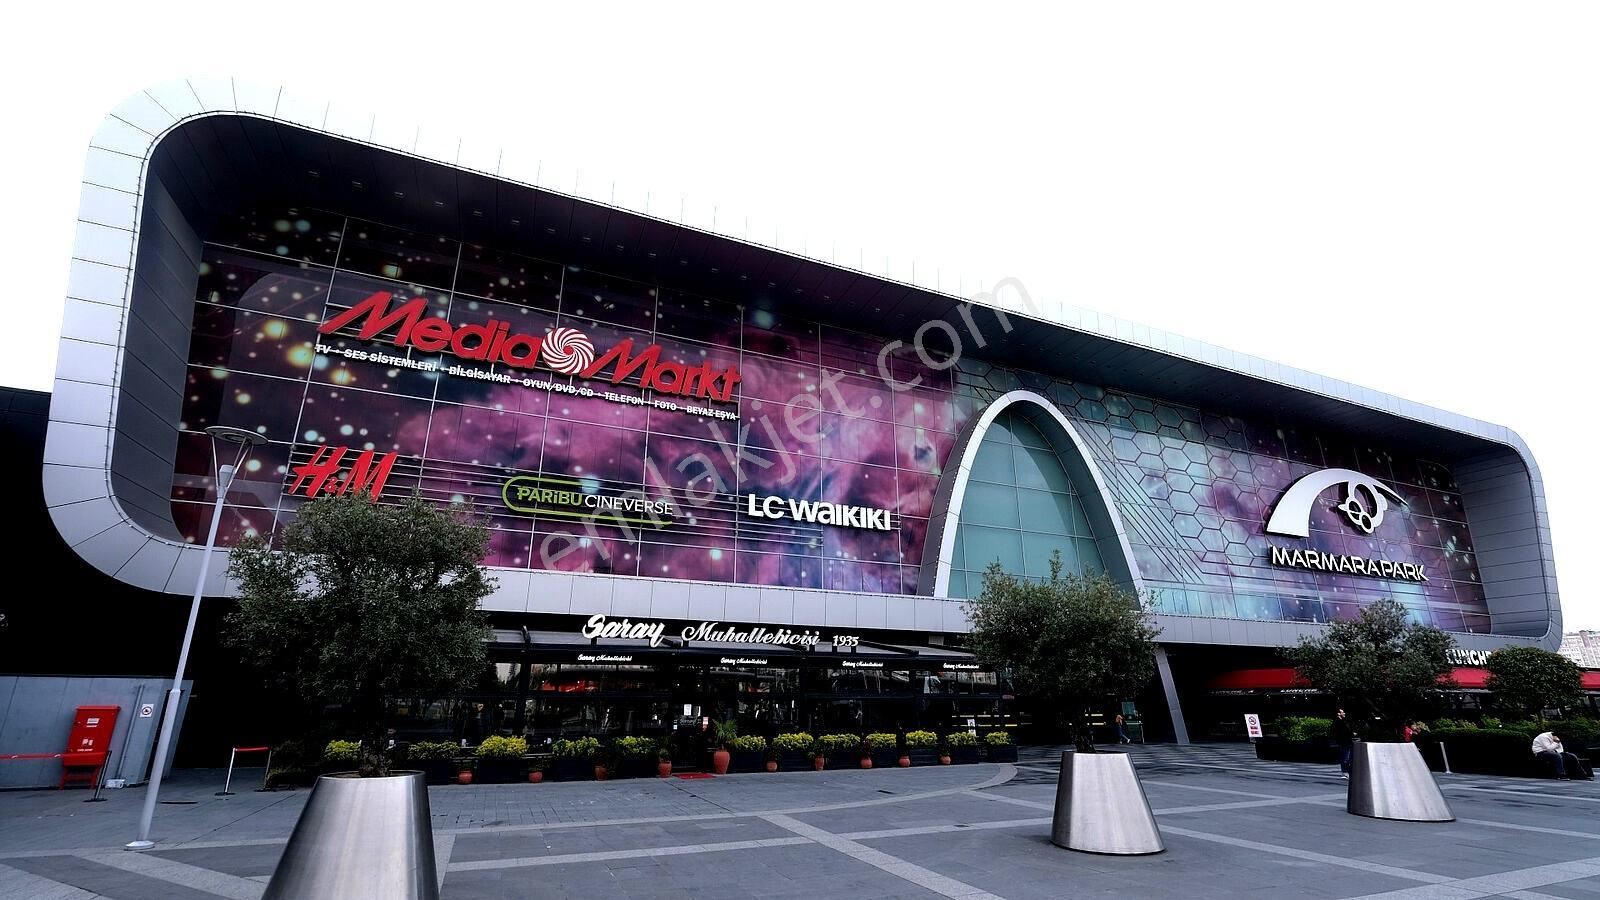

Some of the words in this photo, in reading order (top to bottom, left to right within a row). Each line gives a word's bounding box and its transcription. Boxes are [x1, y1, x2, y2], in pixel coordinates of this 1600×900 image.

[318, 290, 541, 369] Media
[581, 339, 742, 401] Markt
[315, 344, 331, 354] TV
[344, 349, 367, 360] SES
[605, 391, 644, 406] TELEFON
[655, 400, 677, 411] FOTO
[288, 444, 398, 505] H&M
[585, 494, 673, 515] CINEVERSE
[748, 493, 785, 519] LC
[582, 613, 665, 648] Saray
[681, 621, 820, 647] Muhallebicisi
[832, 635, 859, 647] 1935
